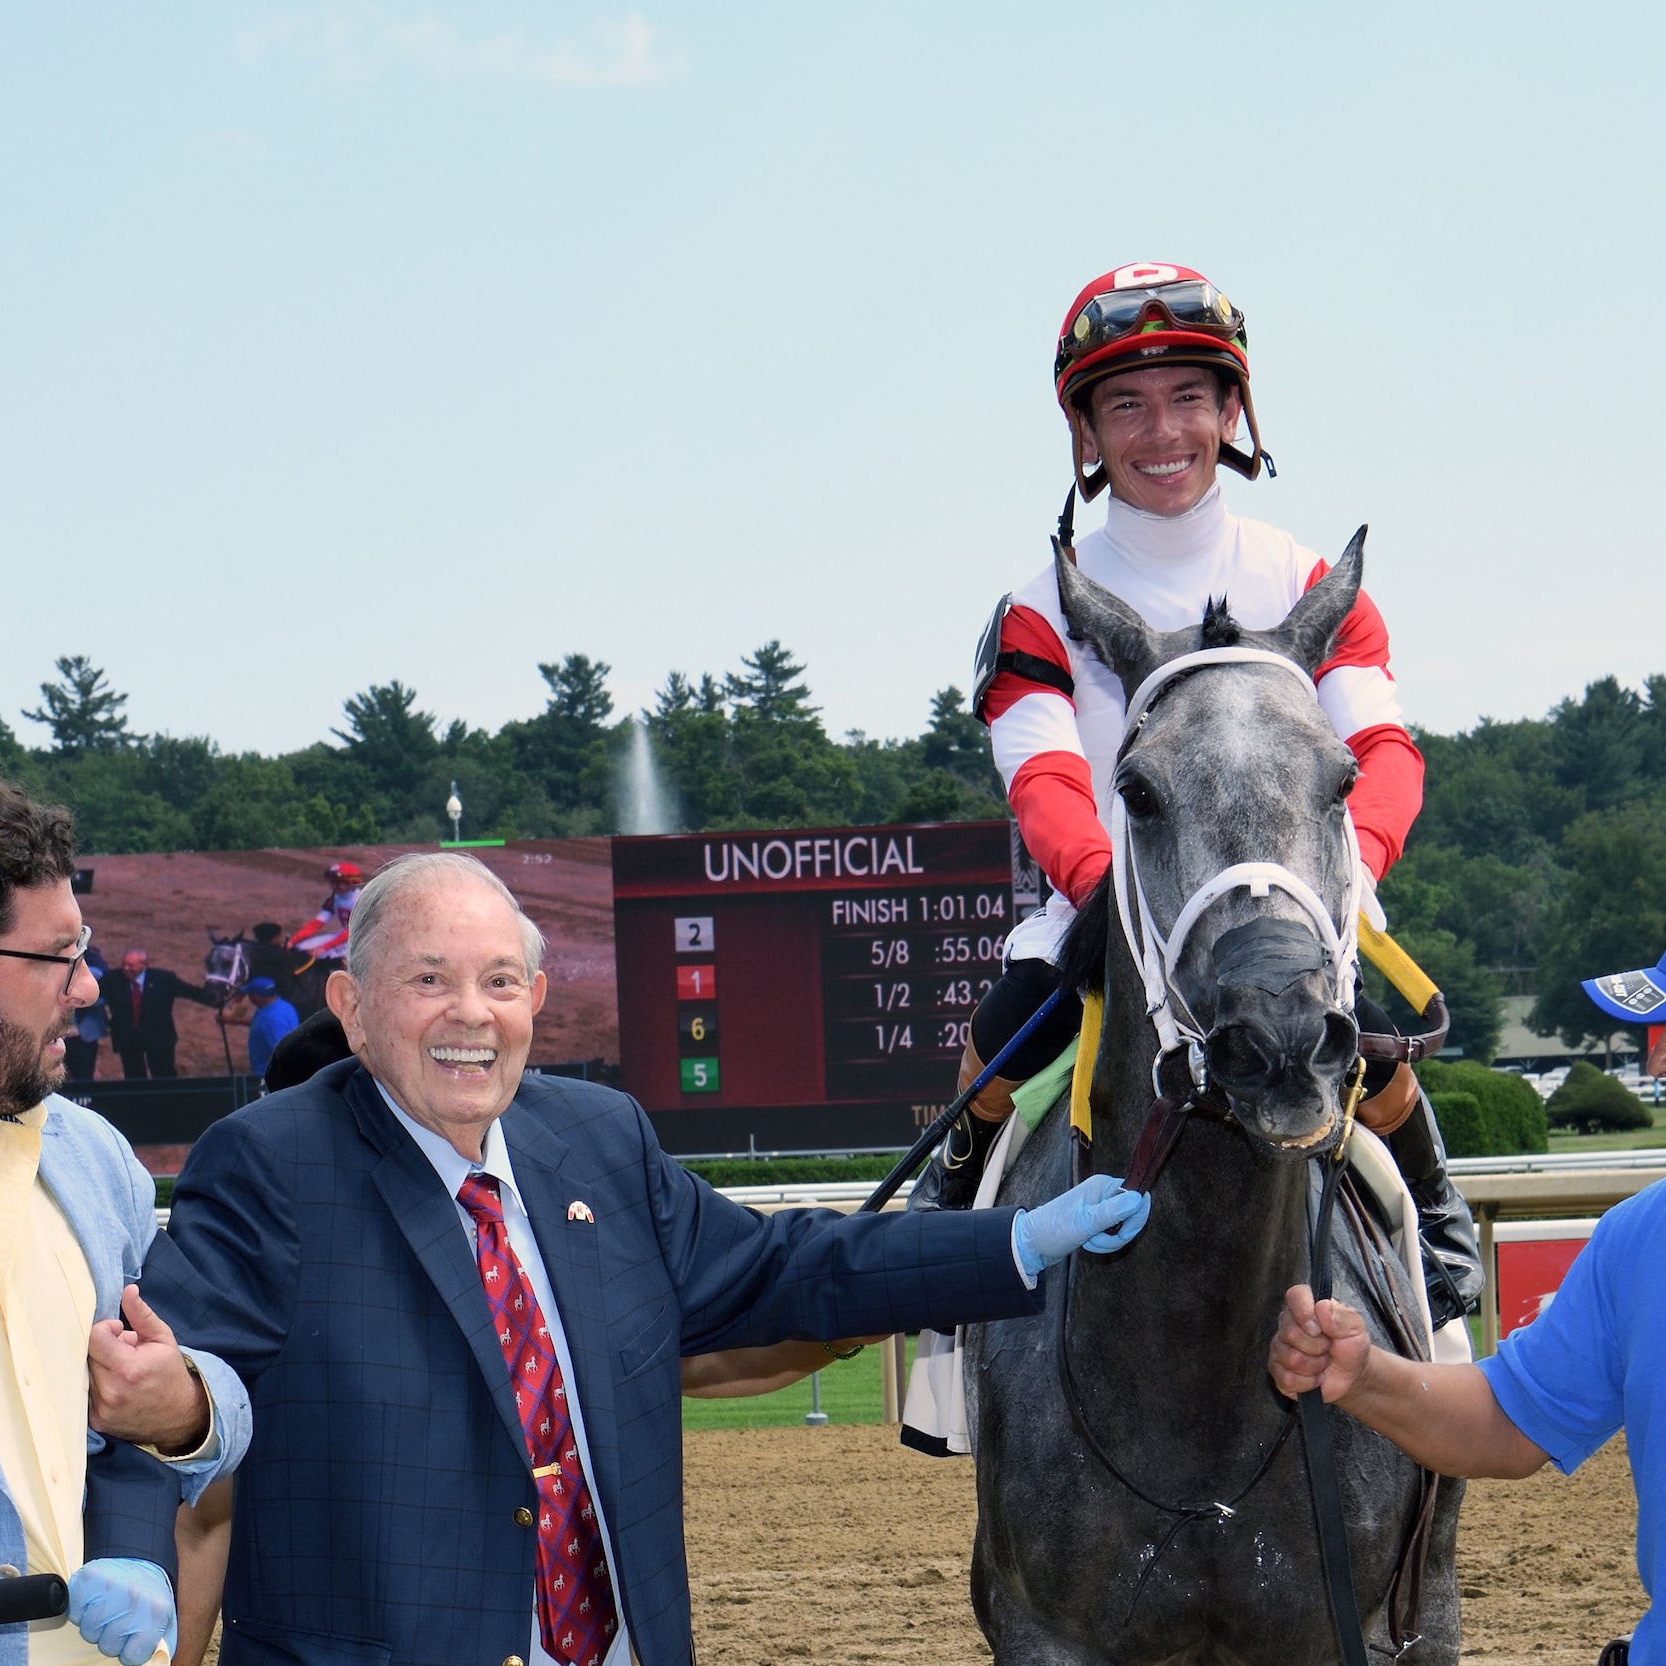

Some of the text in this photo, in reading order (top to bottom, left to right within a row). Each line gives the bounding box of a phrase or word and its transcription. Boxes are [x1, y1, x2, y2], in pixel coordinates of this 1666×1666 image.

[704, 836, 924, 882] UNOFFICIAL
[833, 894, 1005, 925] FINISH 1:01.04
[688, 923, 701, 946] 2
[871, 935, 1004, 969] 5/8 :55.06
[691, 970, 701, 994] 1
[874, 983, 910, 1011] 1/2
[691, 1017, 705, 1041] 6
[875, 1025, 913, 1053] 1/4
[693, 1064, 707, 1087] 5
